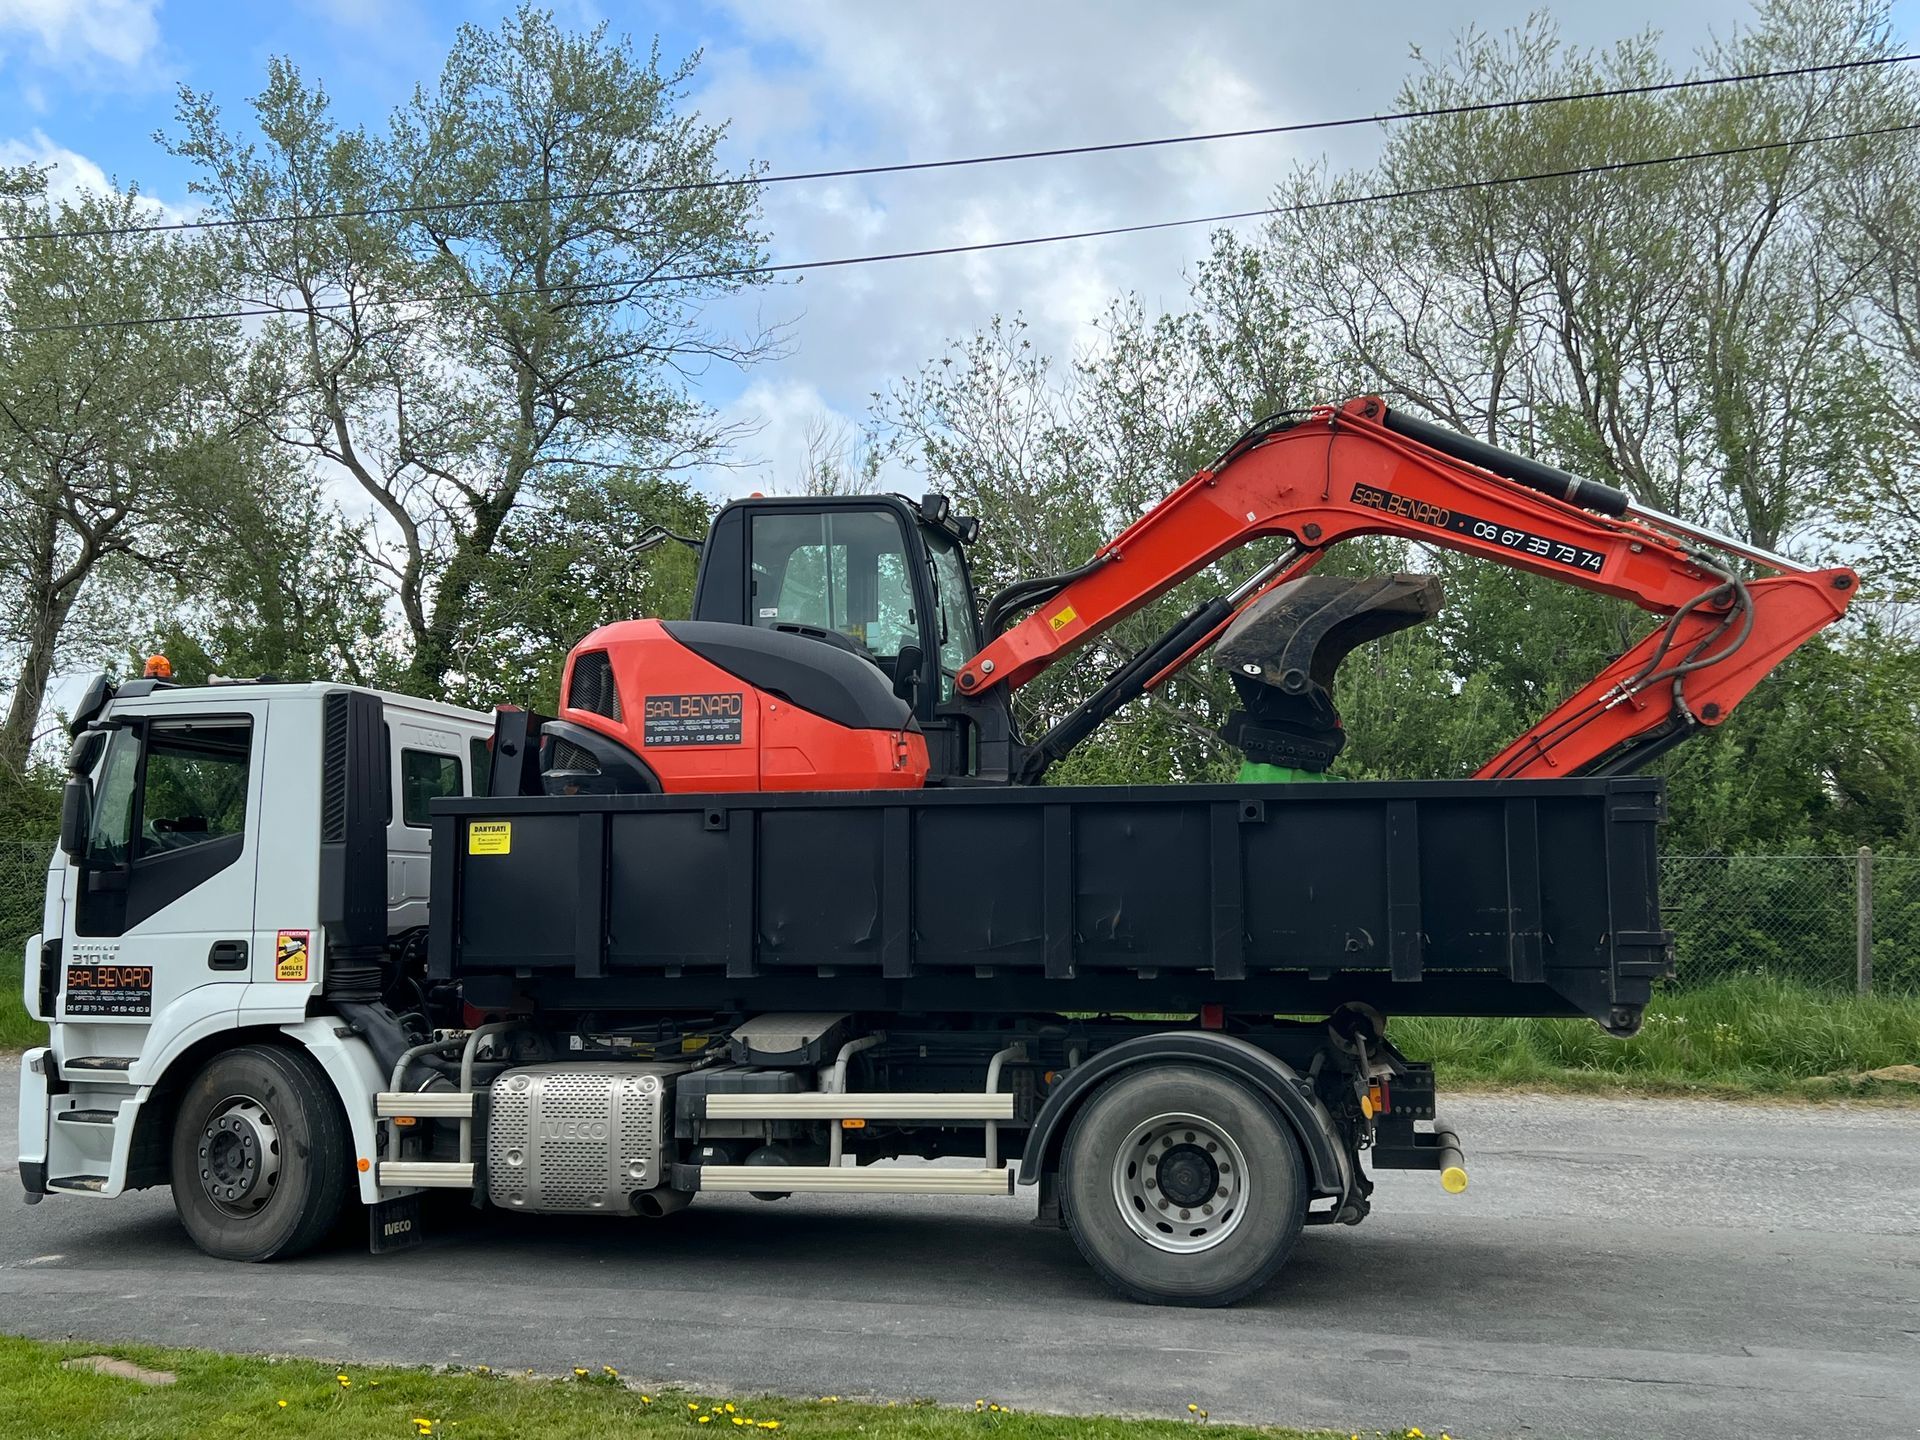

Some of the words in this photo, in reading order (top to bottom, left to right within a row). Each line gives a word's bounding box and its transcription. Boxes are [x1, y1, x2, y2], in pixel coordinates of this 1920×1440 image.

[1353, 488, 1386, 511] SARL
[1387, 494, 1450, 527] BENARD
[1473, 522, 1498, 540] 06
[1501, 530, 1525, 547] 67
[1526, 537, 1551, 556] 33
[1555, 544, 1577, 563] 73
[1580, 552, 1602, 571] 74
[646, 701, 680, 717] SARL
[680, 695, 741, 717] BENARD
[72, 953, 101, 965] 310
[68, 971, 97, 987] SARL
[97, 967, 151, 988] BENARD
[539, 1121, 608, 1140] IVECO
[384, 1219, 412, 1236] IVECO
